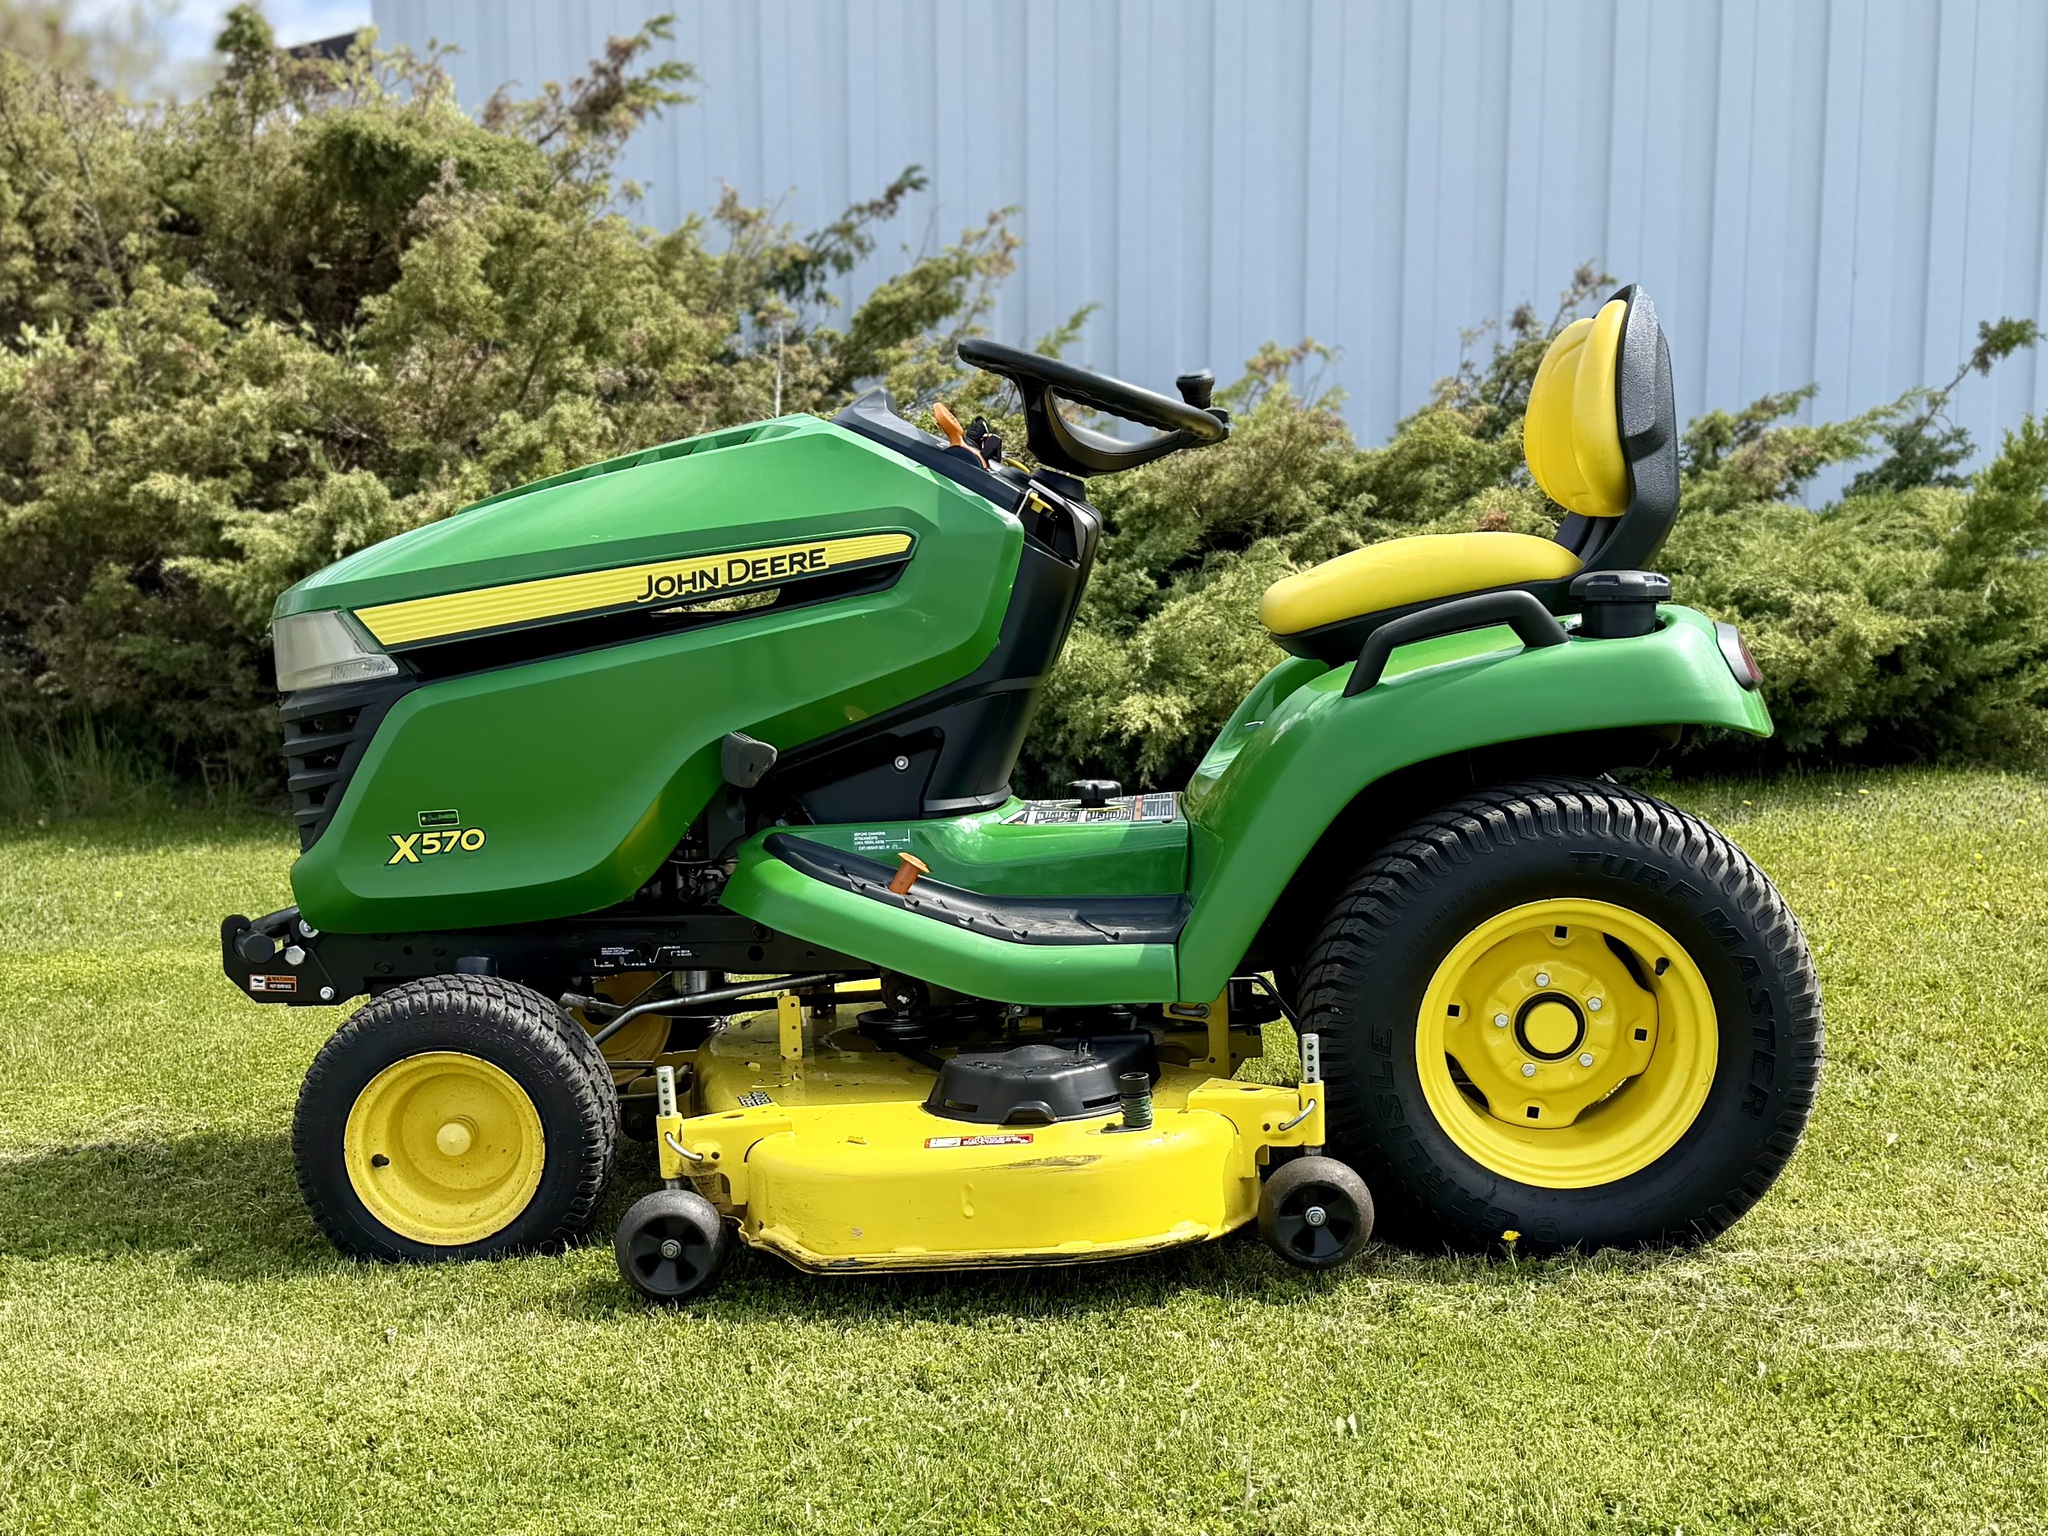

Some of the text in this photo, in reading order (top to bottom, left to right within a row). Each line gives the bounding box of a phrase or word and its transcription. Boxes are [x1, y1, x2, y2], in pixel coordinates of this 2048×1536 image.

[636, 547, 827, 601] JOHN DEERE
[385, 828, 487, 866] X570
[1567, 850, 1778, 1121] TURF MASTER
[453, 1019, 557, 1087] MASTER
[1369, 1022, 1520, 1232] CARLISLE
